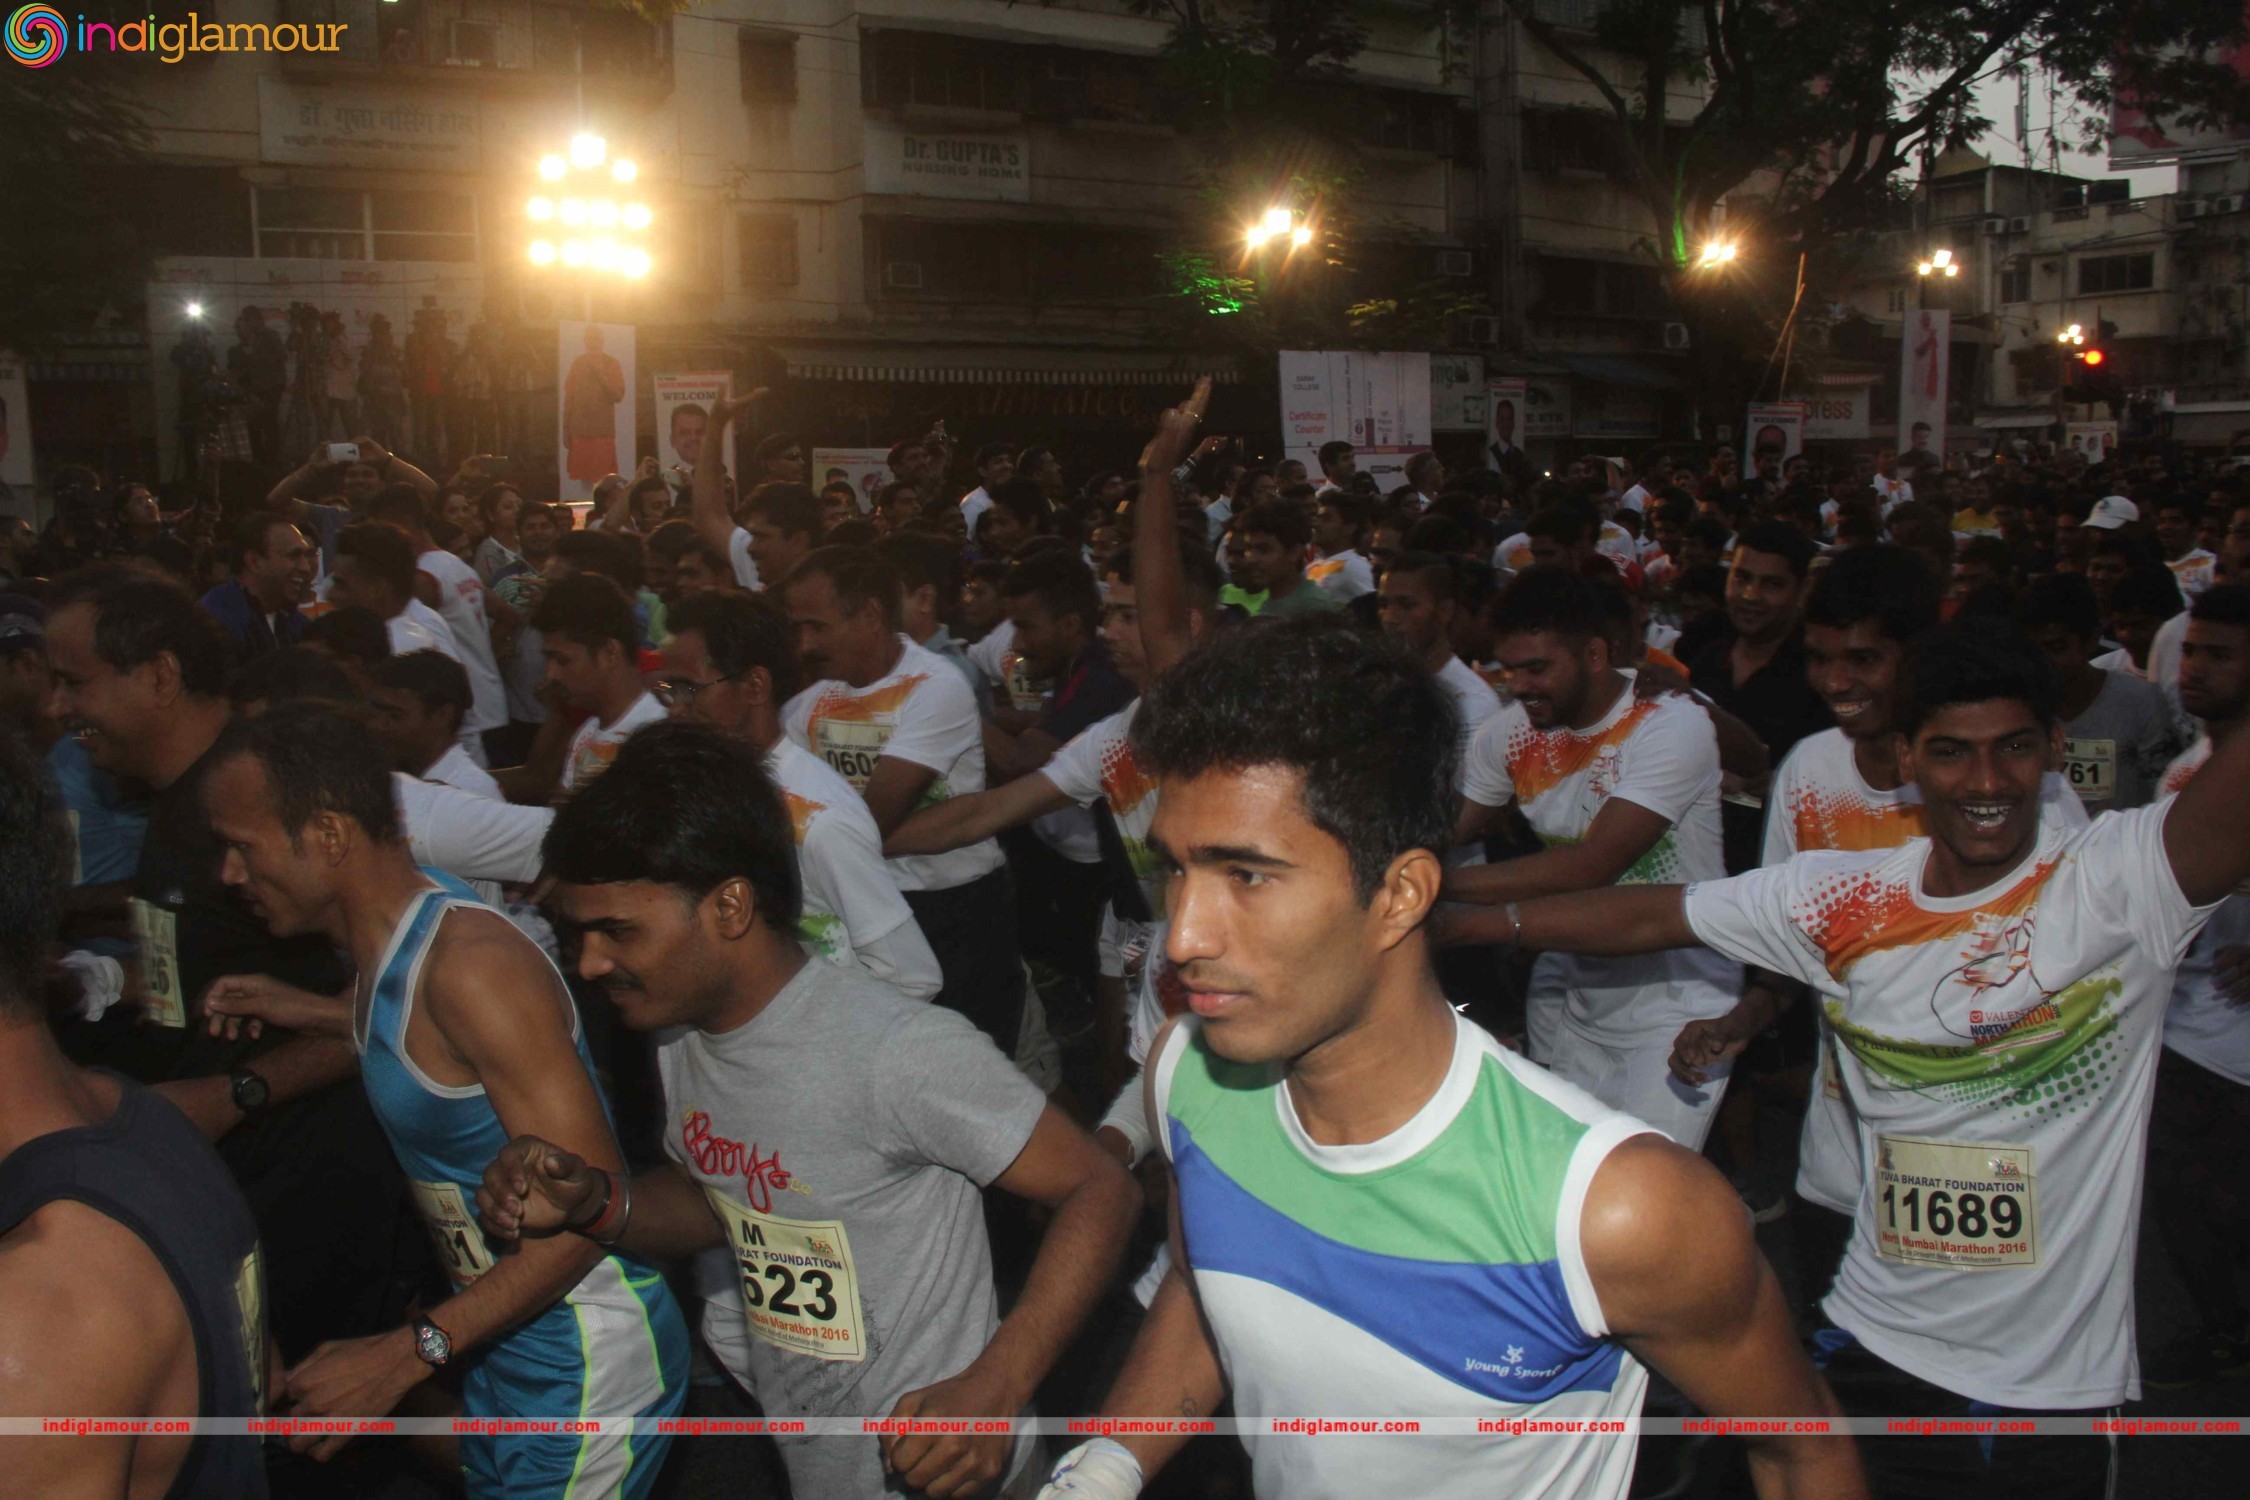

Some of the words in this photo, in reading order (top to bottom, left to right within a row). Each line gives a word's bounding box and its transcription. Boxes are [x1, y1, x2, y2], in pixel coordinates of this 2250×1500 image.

[903, 136, 931, 159] Dr.
[936, 138, 1020, 166] GUPTA'S
[902, 162, 970, 176] NURSING
[978, 167, 1022, 179] HOME
[662, 391, 721, 401] WELCOM
[1970, 1023, 2007, 1036] NORTH
[683, 1111, 792, 1215] Boys
[1901, 1174, 1942, 1189] BHARAT
[1944, 1179, 2026, 1193] FOUNDATION
[1882, 1184, 2023, 1239] 11689
[741, 1219, 766, 1247] M
[1902, 1235, 1938, 1251] Mumbai
[1940, 1241, 1995, 1255] Marathon
[1998, 1242, 2028, 1254] 2016
[763, 1250, 843, 1270] FOUNDATION
[770, 1316, 819, 1337] Marathon
[821, 1326, 850, 1341] 2016
[1465, 1355, 1511, 1378] Young
